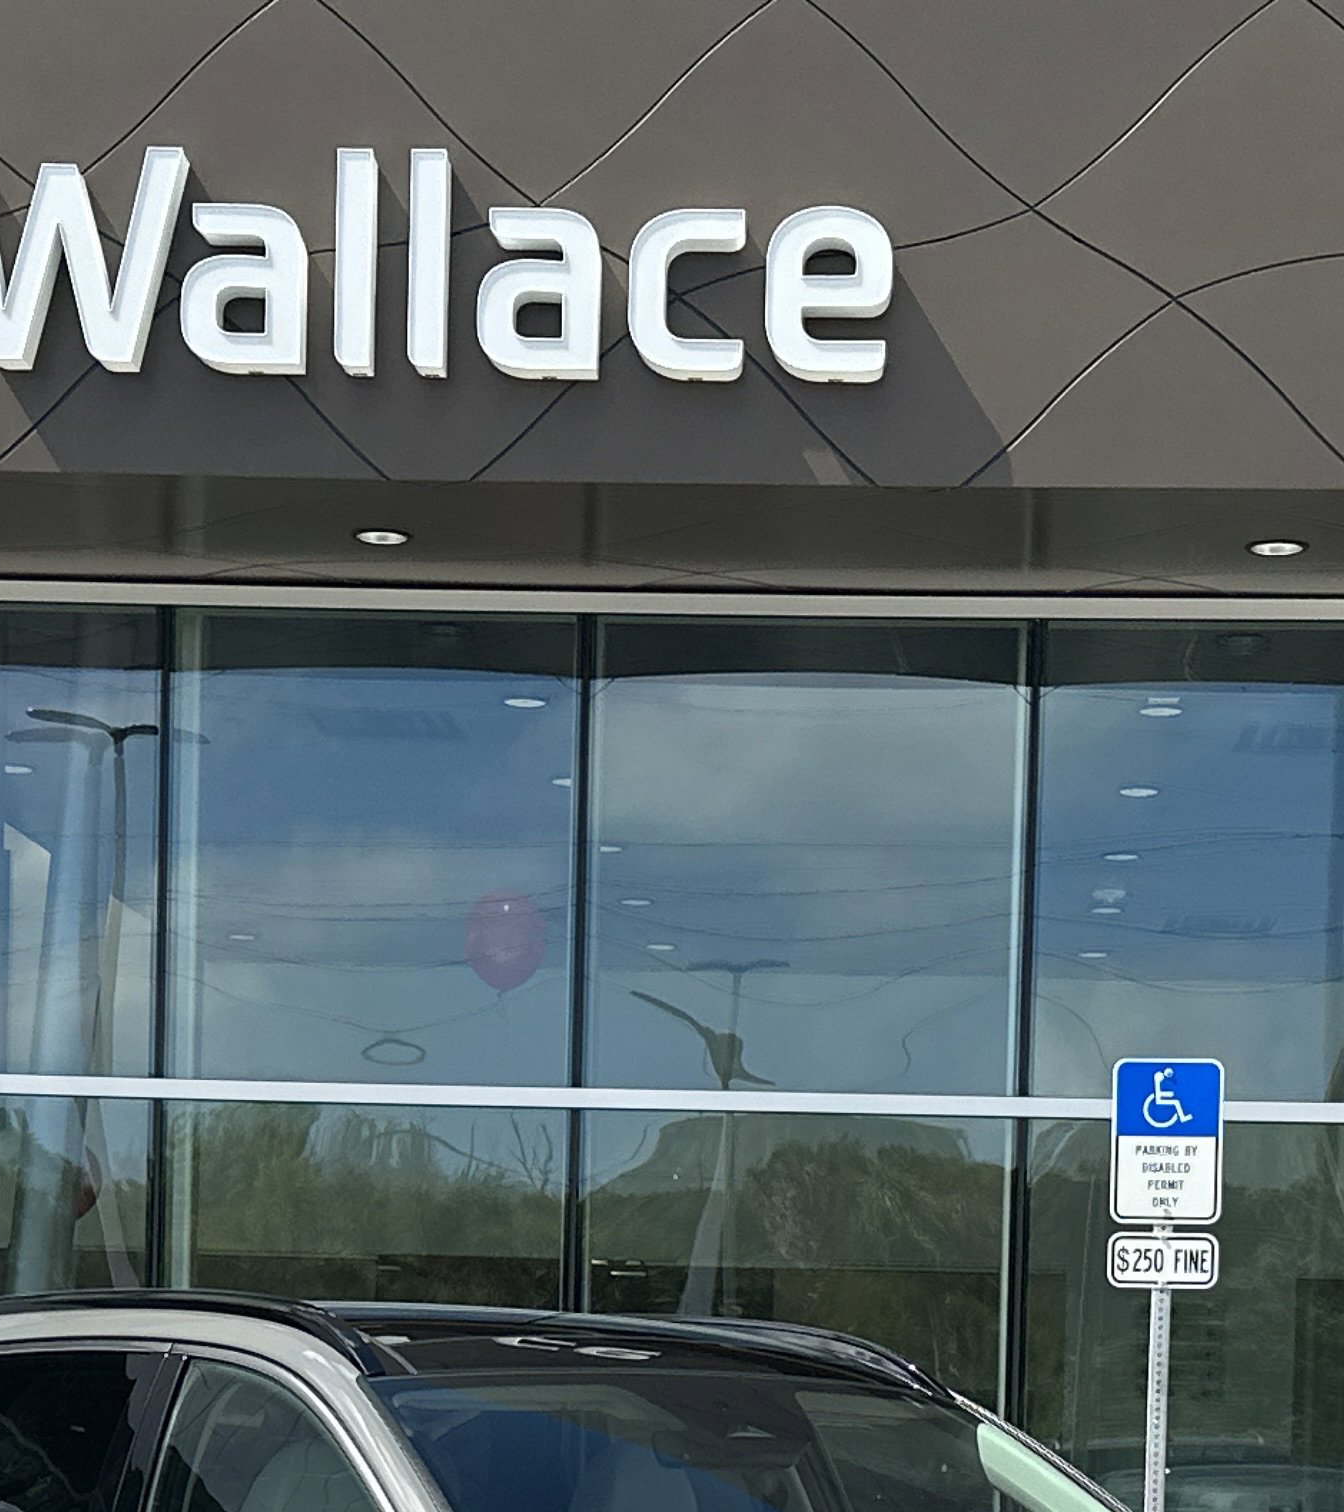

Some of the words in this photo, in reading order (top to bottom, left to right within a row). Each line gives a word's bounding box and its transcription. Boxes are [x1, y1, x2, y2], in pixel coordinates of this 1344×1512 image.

[1136, 1145, 1179, 1156] PARKING
[1185, 1145, 1198, 1156] BY
[1142, 1163, 1191, 1173] DISABLED
[1147, 1180, 1184, 1190] PERMIT
[1152, 1197, 1179, 1208] ONLY
[1117, 1246, 1164, 1275] $250
[1174, 1248, 1209, 1273] FINE
